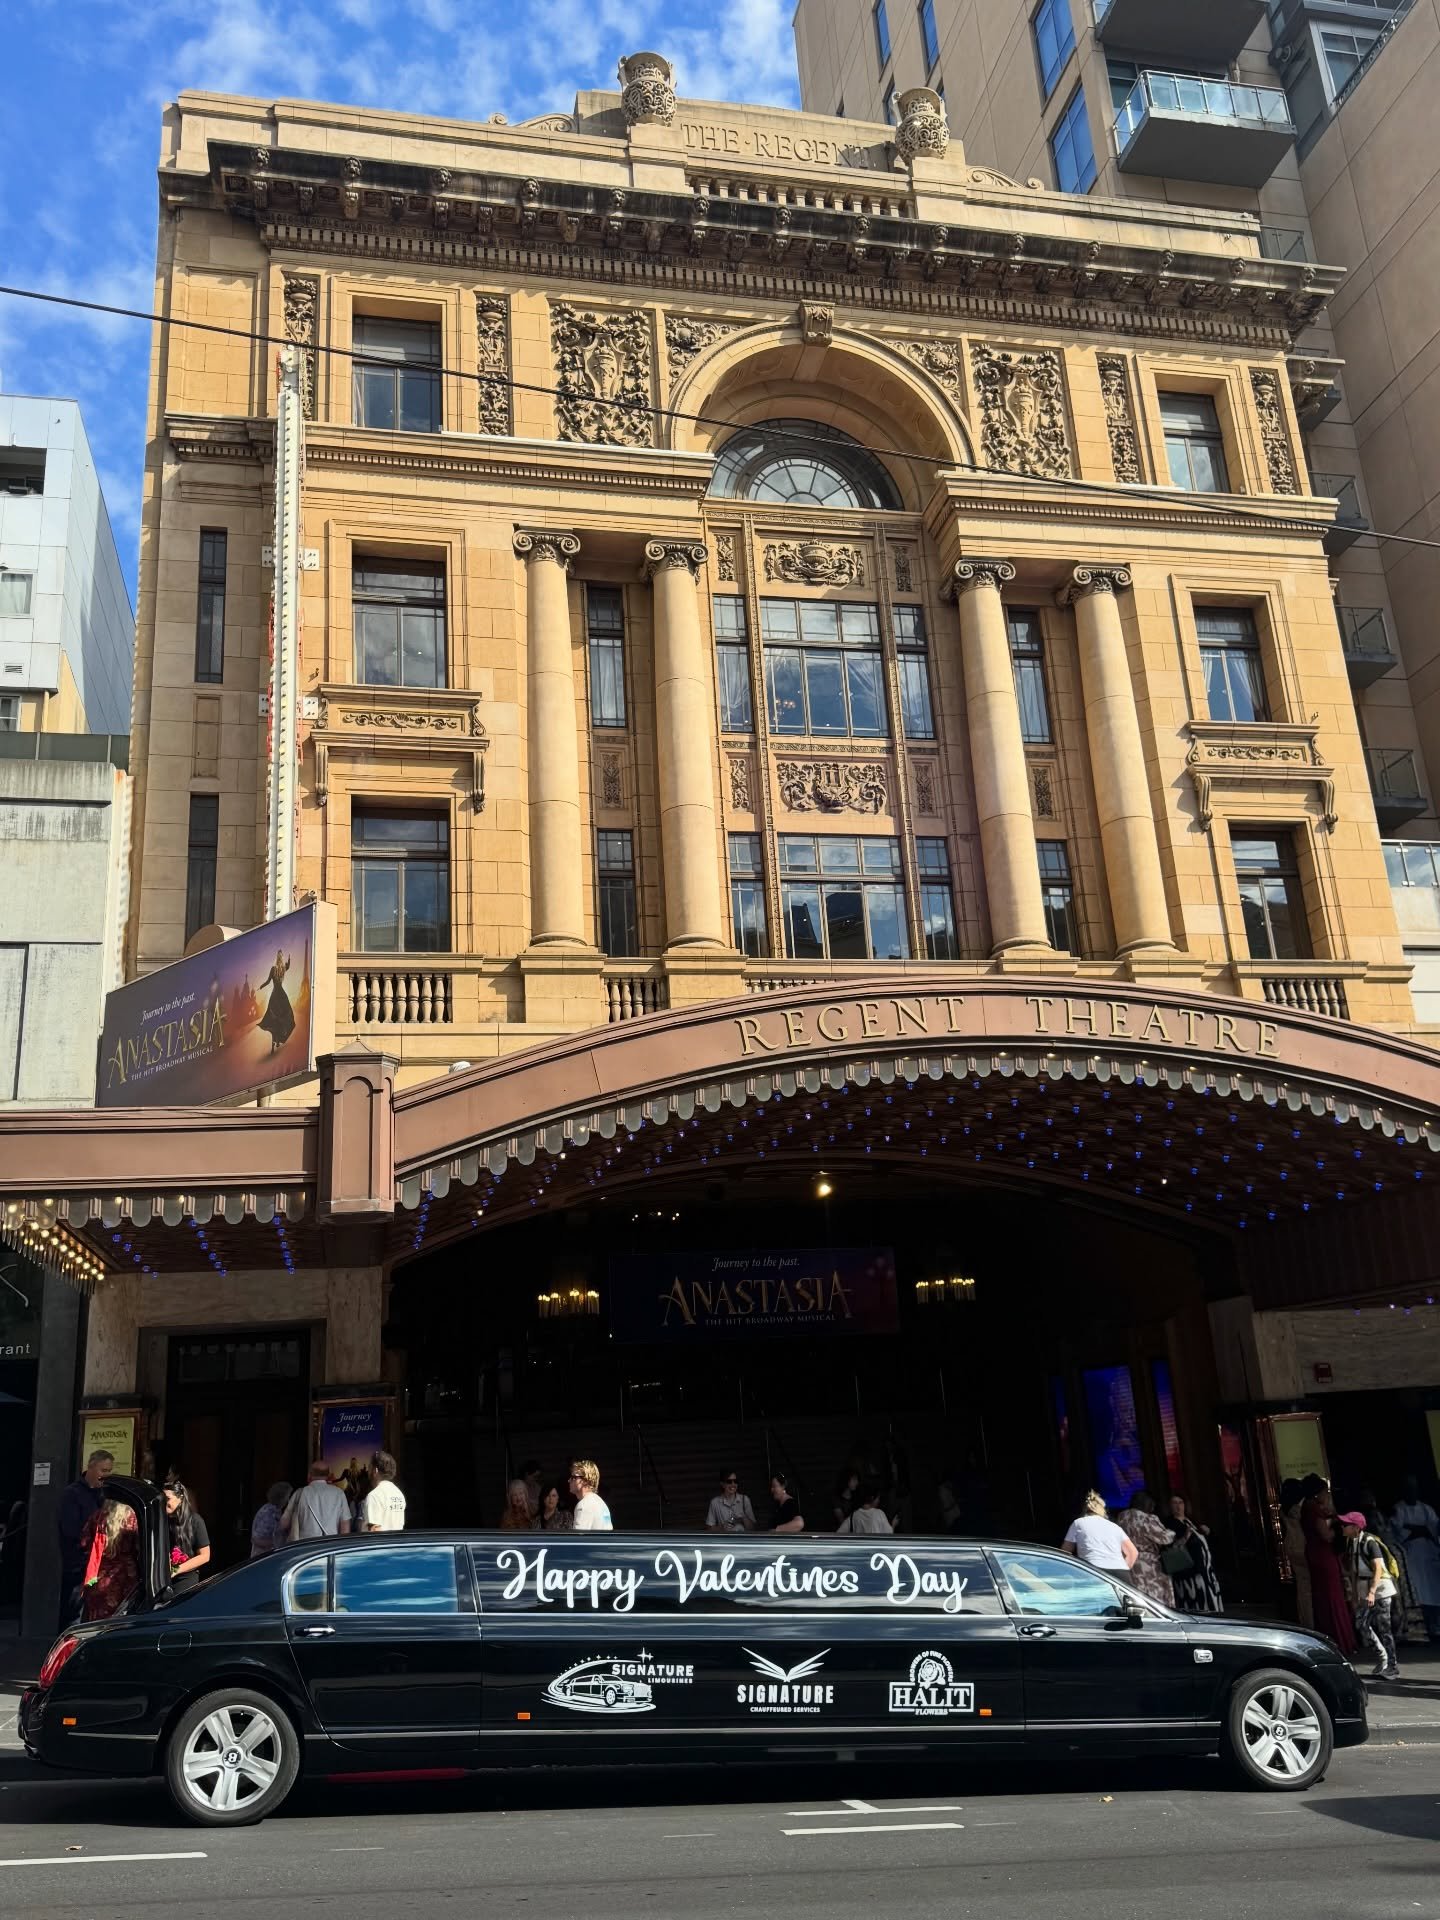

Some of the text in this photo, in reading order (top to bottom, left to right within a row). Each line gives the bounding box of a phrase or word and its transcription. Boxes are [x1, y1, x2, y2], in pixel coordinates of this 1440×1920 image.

[680, 123, 871, 169] THE REGENT
[140, 1006, 164, 1025] Journey
[171, 997, 182, 1008] the
[735, 996, 1282, 1059] REGENT THEATRE
[107, 997, 227, 1088] ANASTASIA
[131, 1046, 213, 1081] THE HIT BROADWAY MUSICAL
[711, 1257, 750, 1271] Journey
[752, 1258, 760, 1266] to
[761, 1256, 776, 1266] the
[657, 1270, 855, 1327] ANASTASIA
[705, 1314, 836, 1327] THE HIT BROADWAY MUSICAL
[331, 1425, 341, 1433] to
[341, 1423, 355, 1432] the
[337, 1413, 372, 1424] Journey
[496, 1548, 968, 1613] Happy Valentines Day
[612, 1663, 694, 1677] SIGNATURE
[737, 1684, 834, 1703] SIGNATURE
[893, 1687, 970, 1707] HALIT
[915, 1708, 949, 1716] FLOWERS
